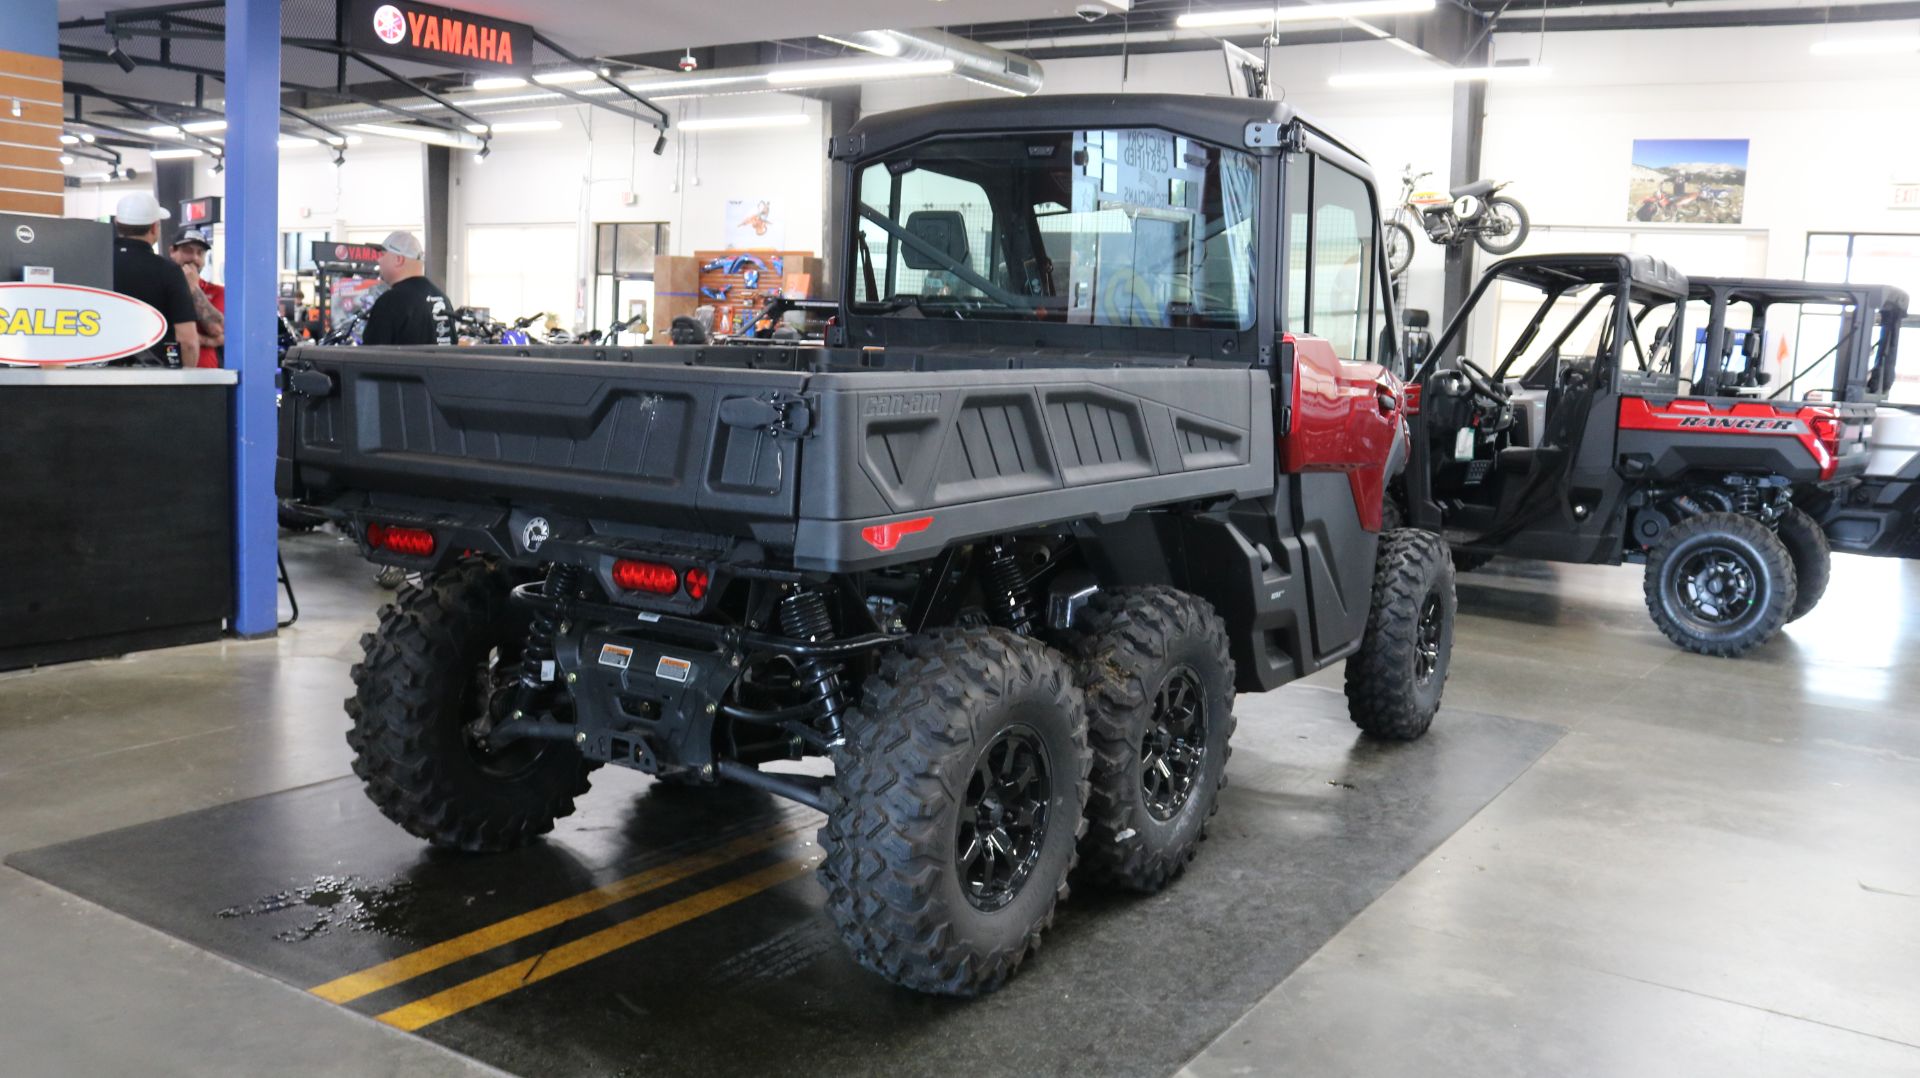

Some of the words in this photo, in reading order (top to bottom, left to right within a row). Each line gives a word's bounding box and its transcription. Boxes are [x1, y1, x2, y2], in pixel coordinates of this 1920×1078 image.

[407, 11, 513, 65] YAMAHA
[1461, 198, 1469, 214] 1
[1680, 416, 1793, 430] RANGER
